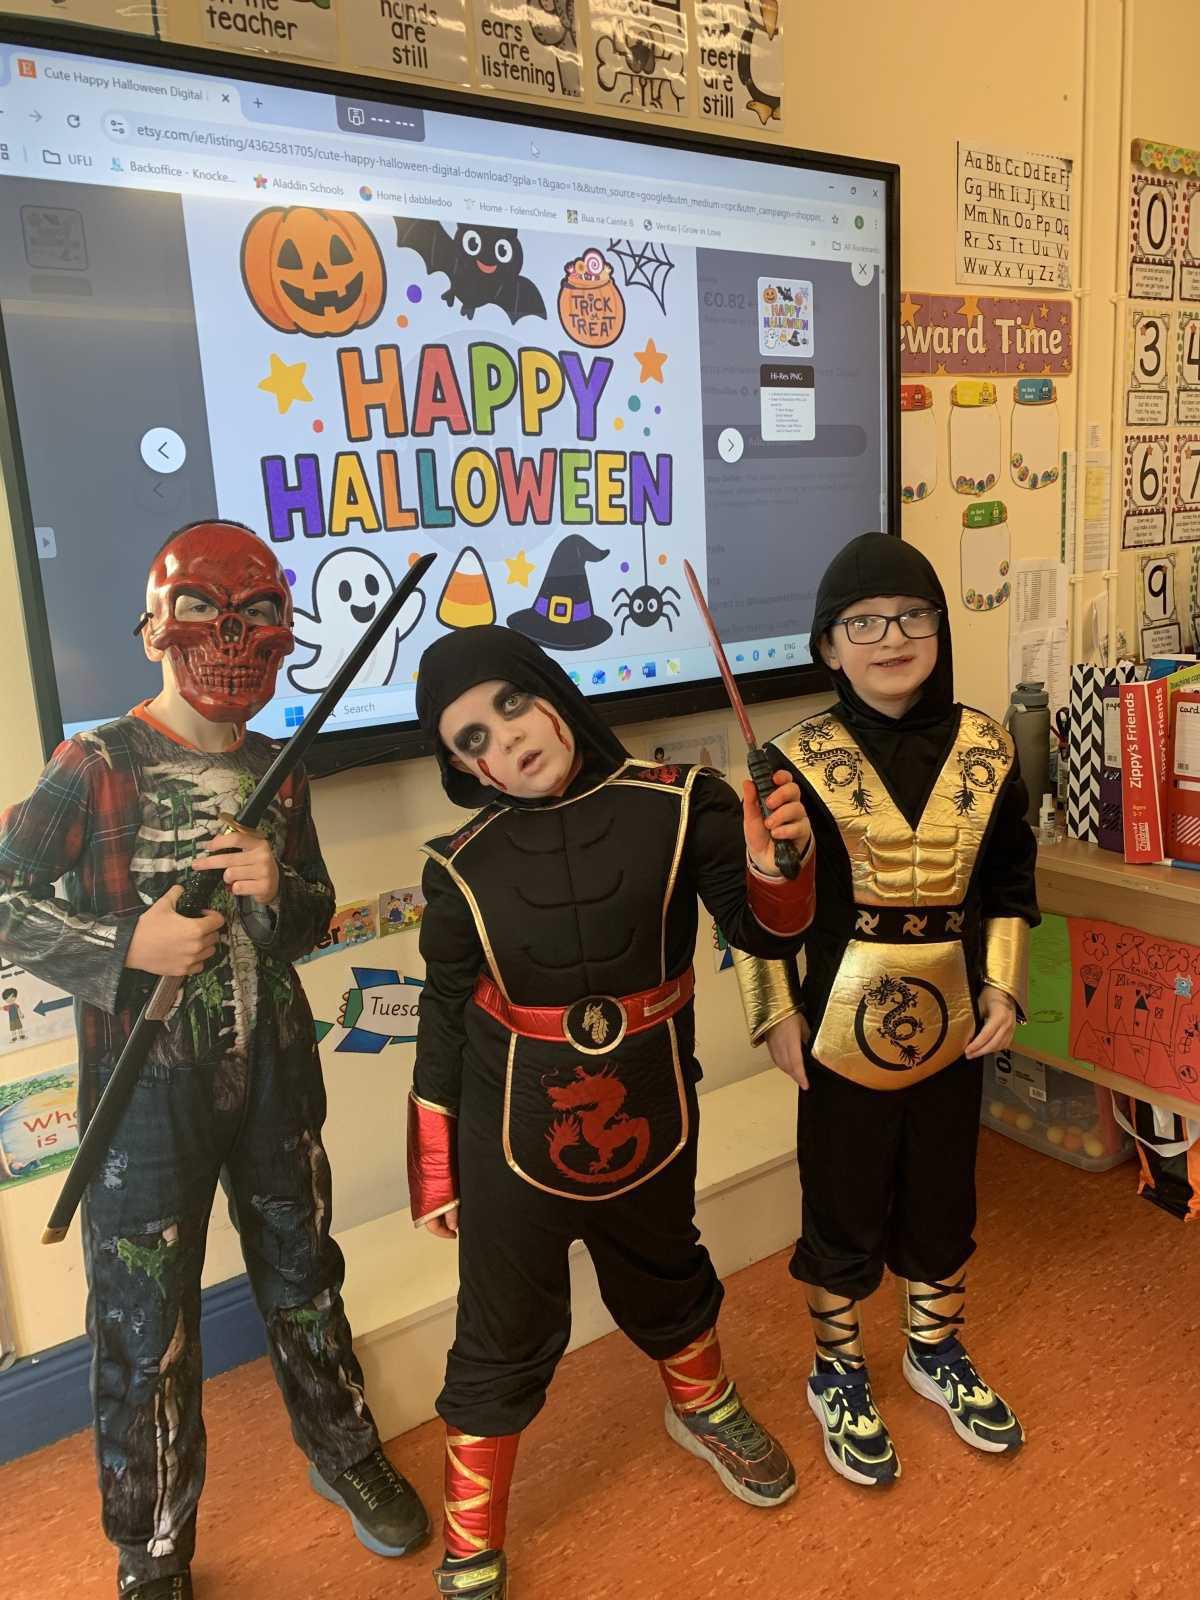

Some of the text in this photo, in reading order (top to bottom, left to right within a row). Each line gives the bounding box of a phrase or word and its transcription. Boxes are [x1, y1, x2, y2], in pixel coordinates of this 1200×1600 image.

[206, 5, 298, 41] teacher
[391, 19, 427, 44] are
[481, 18, 523, 42] ears
[392, 45, 428, 70] still
[498, 41, 530, 63] are
[44, 67, 203, 101] Cute Happy Halloween Digital
[482, 54, 555, 93] listening
[702, 94, 734, 118] still
[130, 160, 183, 178] Backoffice
[965, 151, 1070, 191] Aa Bb Cc Dd Ee Ff
[272, 177, 345, 196] Aladdin Schools
[376, 190, 402, 203] Home
[965, 177, 982, 202] Gg
[988, 181, 1005, 200] Hh
[1011, 185, 1020, 203] Ii
[1024, 188, 1035, 211] Jj
[1041, 191, 1056, 208] Kk
[965, 204, 1069, 240] Mm Nn Oo Pp Qq
[964, 231, 1069, 260] Rr Ss Tt Uu Vv
[964, 257, 1054, 285] Ww Xx Yy Zz
[569, 314, 616, 337] TREAT
[993, 316, 1063, 355] Time
[1139, 320, 1161, 377] 3
[336, 341, 614, 442] HAPPY
[1139, 447, 1160, 501] 6
[261, 446, 673, 542] HALLOWEEN
[1147, 564, 1168, 615] 9
[343, 702, 376, 715] Search
[1155, 687, 1165, 737] Friends
[1124, 692, 1144, 789] Zippy's Friends
[36, 1133, 58, 1149] is
